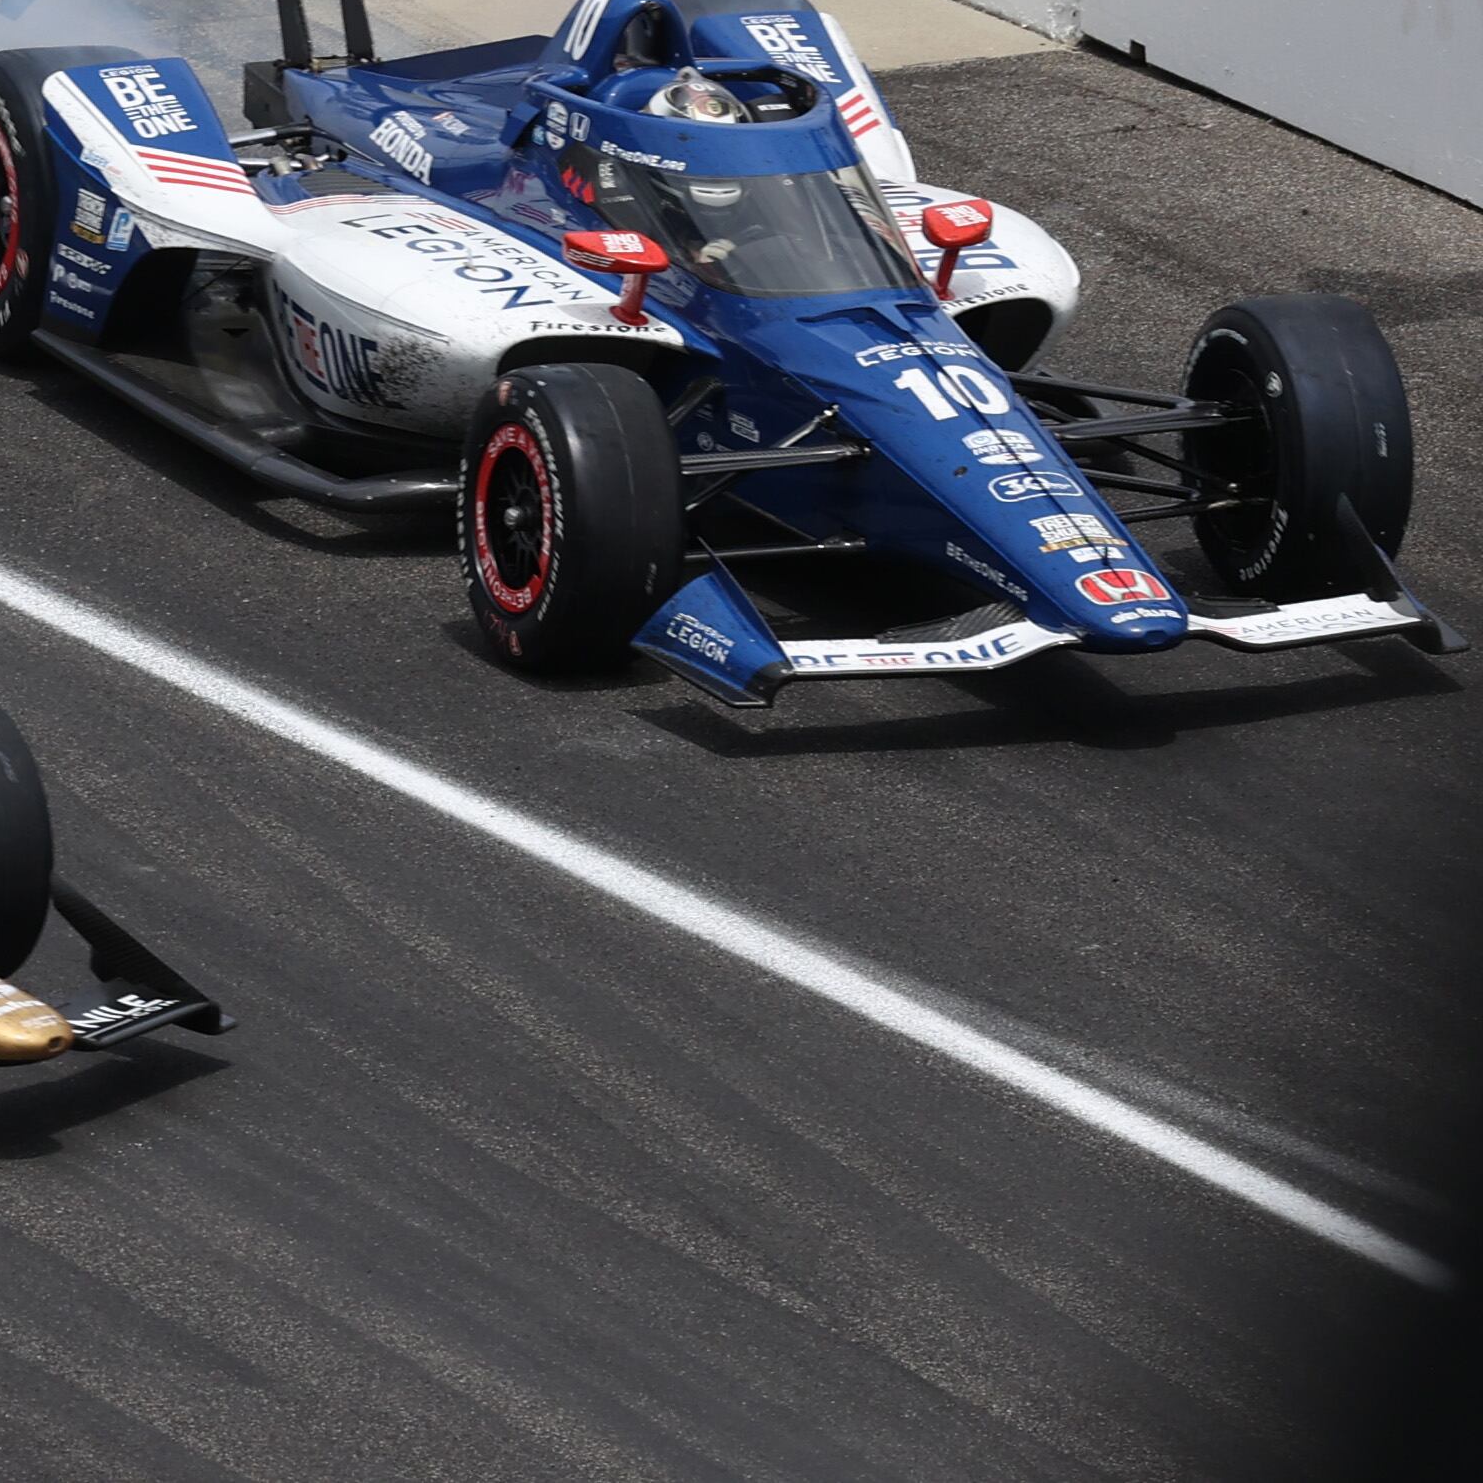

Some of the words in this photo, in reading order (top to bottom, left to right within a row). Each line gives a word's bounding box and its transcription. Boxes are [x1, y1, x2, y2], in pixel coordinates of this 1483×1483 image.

[745, 23, 820, 54] BE
[102, 73, 178, 109] BE
[133, 113, 198, 139] ONE
[138, 103, 166, 118] THE
[368, 116, 436, 187] HONDA
[600, 140, 687, 173] BETHEONE.ORG
[340, 212, 556, 311] LEGION
[461, 229, 595, 302] AMERICAN
[530, 320, 669, 335] Firestone
[319, 321, 406, 410] ONE
[855, 346, 981, 367] LEGION
[893, 364, 1013, 421] 10
[945, 541, 1029, 603] BETHEONE.ORG
[1238, 608, 1375, 636] AMERICAN
[665, 620, 732, 666] LEGION
[921, 631, 1027, 667] ONE
